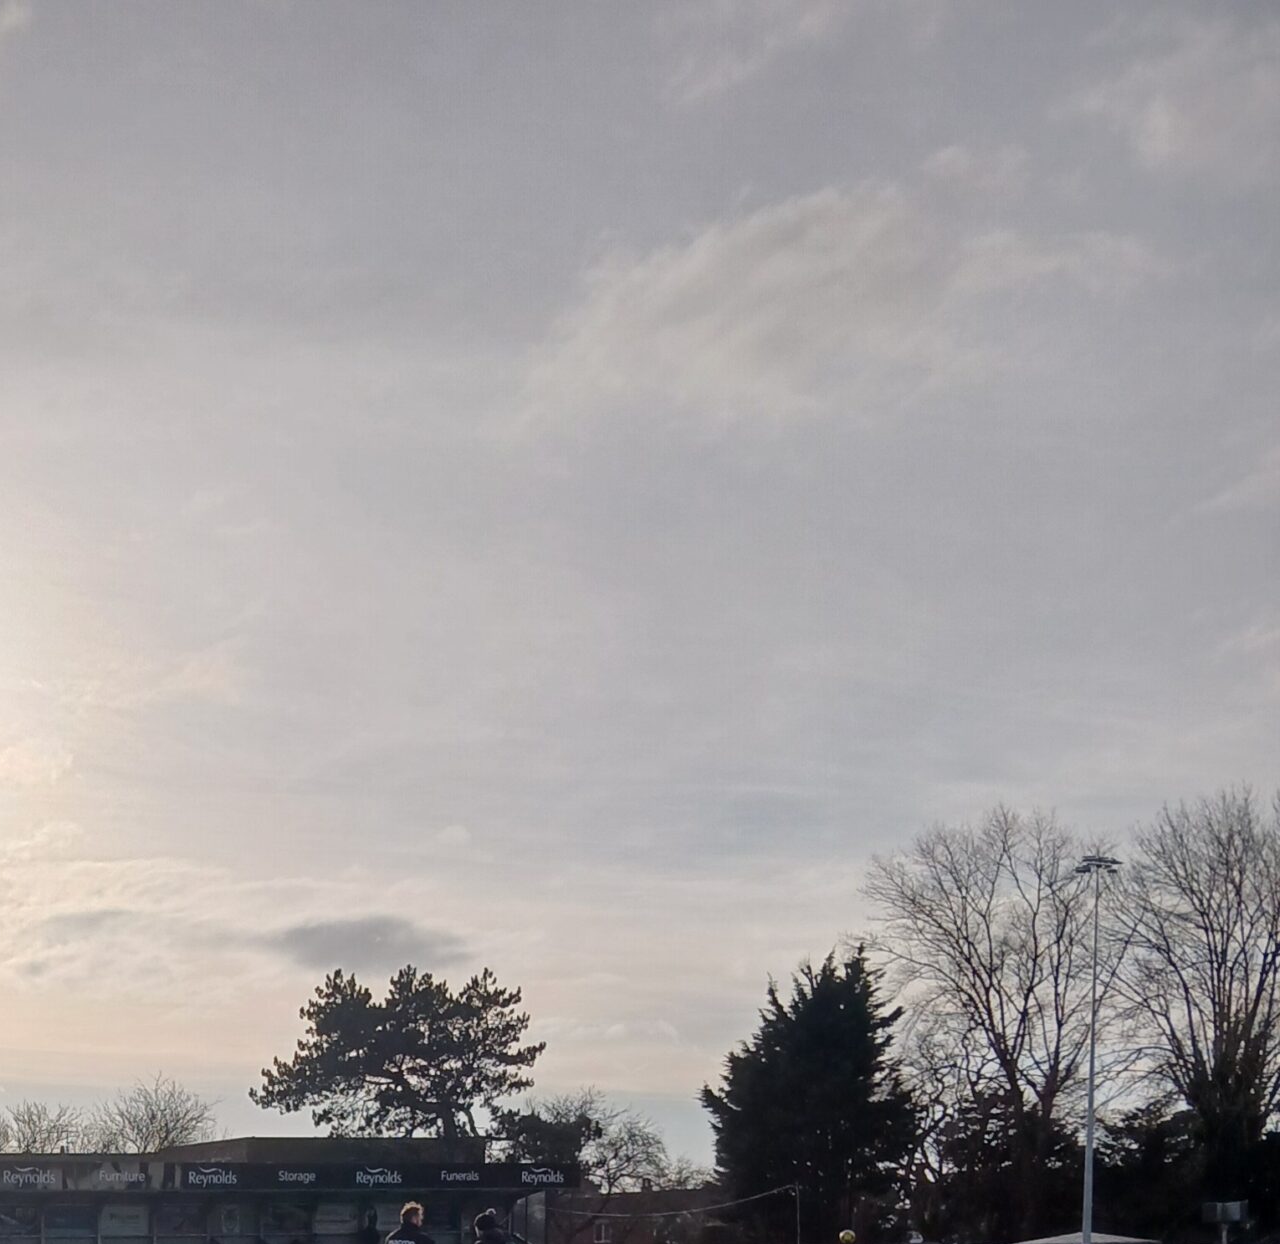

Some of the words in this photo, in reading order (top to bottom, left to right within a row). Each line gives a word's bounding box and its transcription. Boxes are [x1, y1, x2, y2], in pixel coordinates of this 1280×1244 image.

[3, 1168, 56, 1187] Reynolds
[99, 1170, 146, 1182] Furniture
[188, 1168, 238, 1187] Reynolds
[278, 1170, 316, 1183] Storage
[355, 1169, 402, 1187] Reynolds
[440, 1170, 480, 1181] Funerals
[521, 1169, 565, 1186] Reynolds
